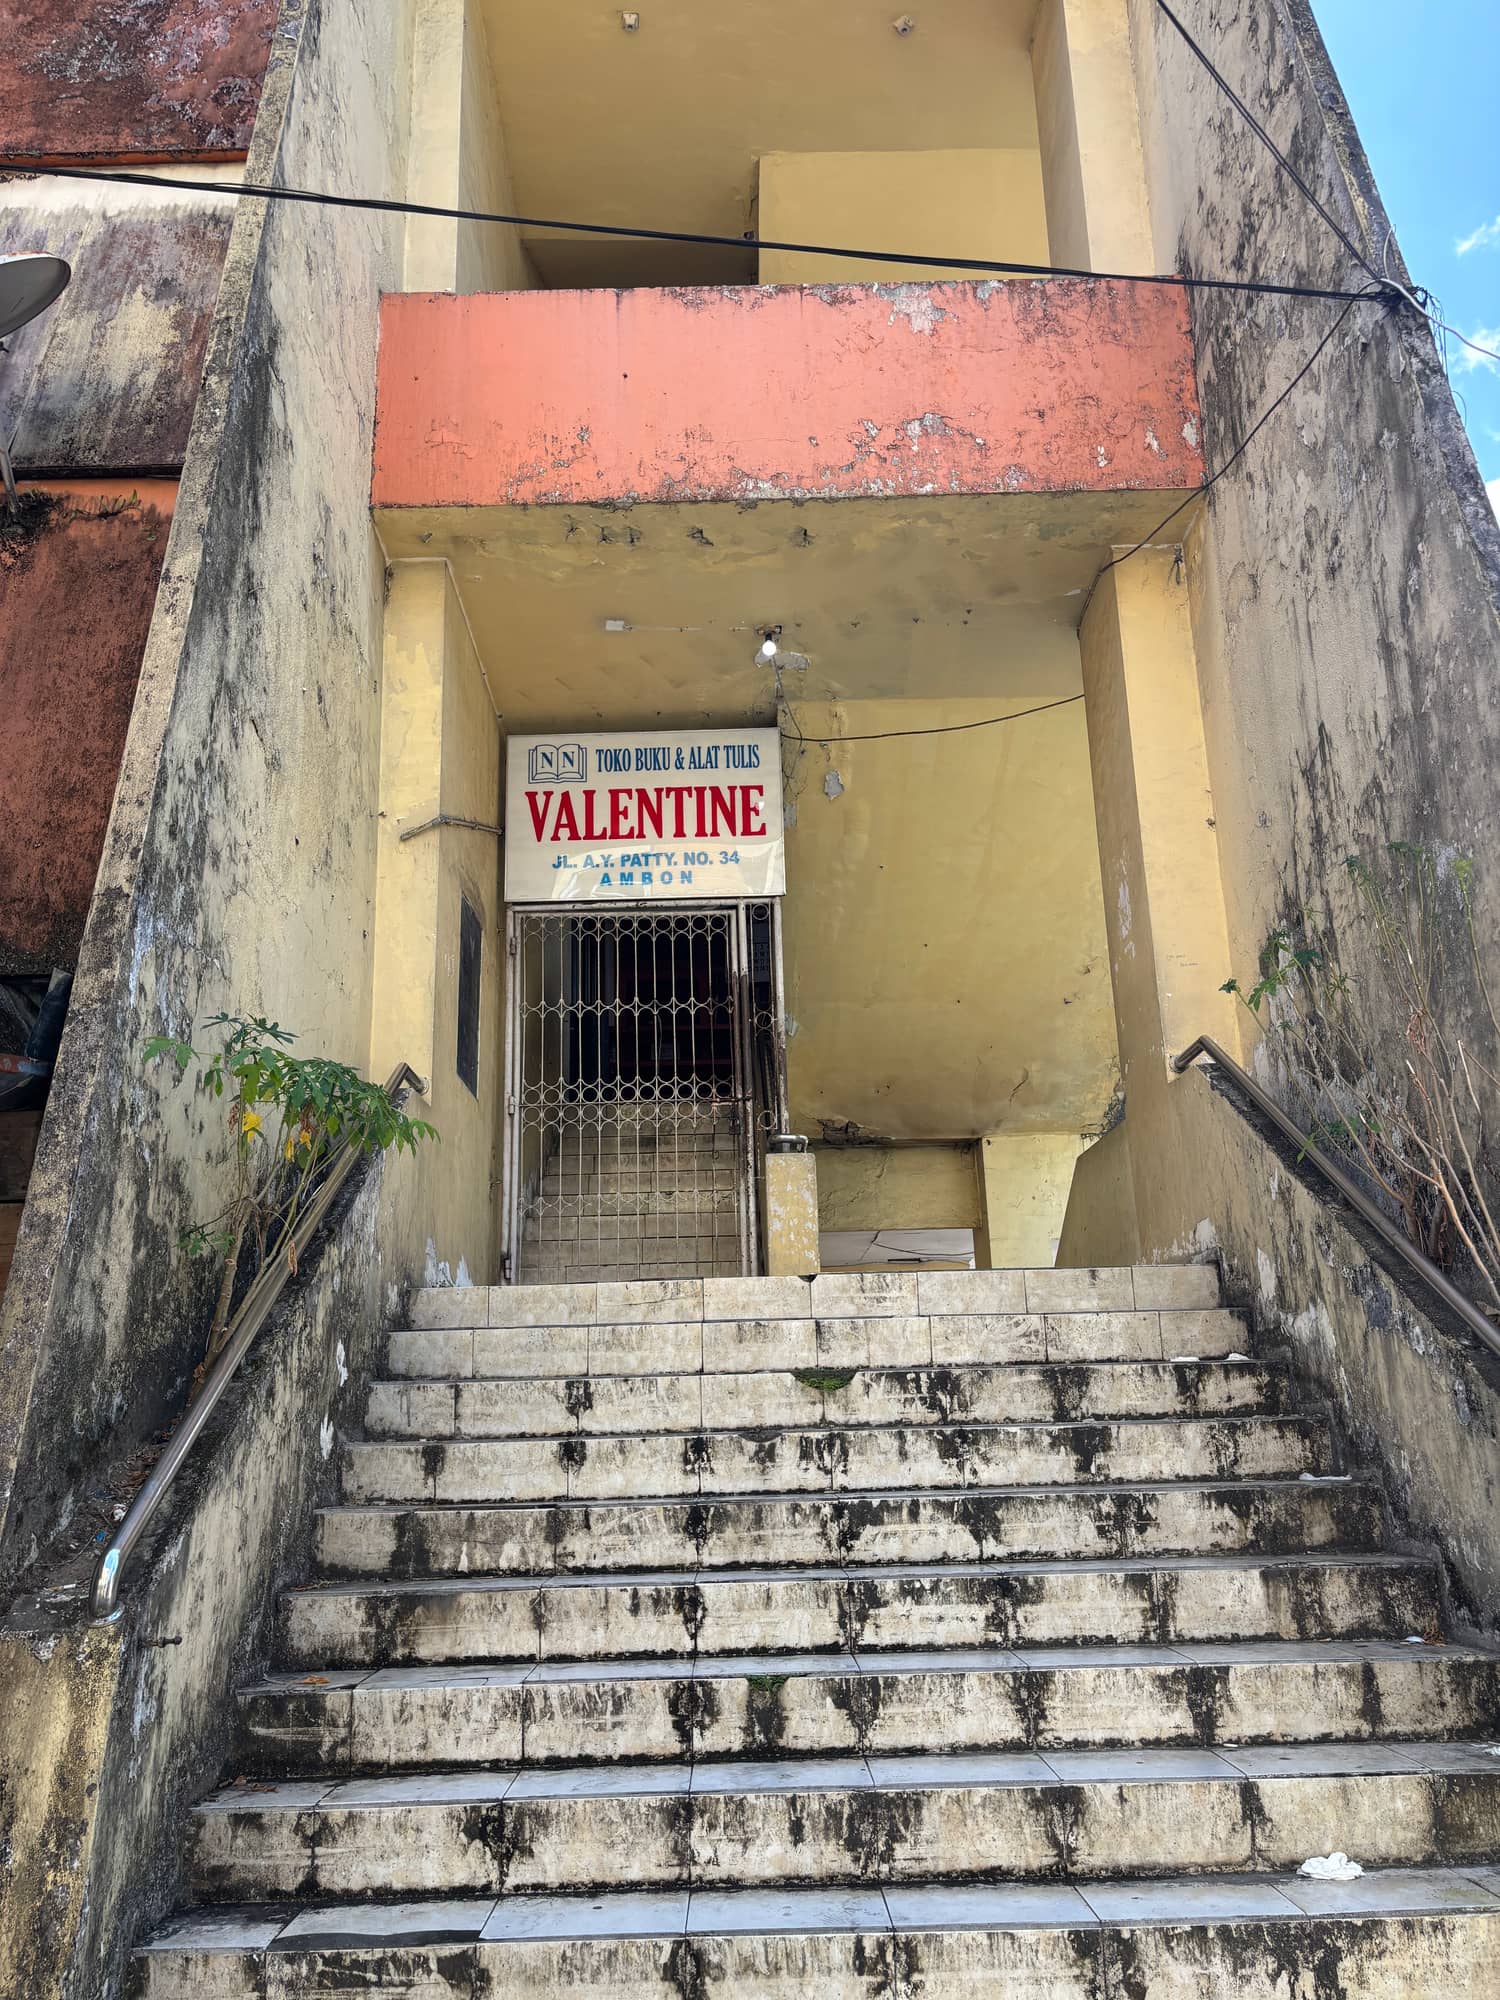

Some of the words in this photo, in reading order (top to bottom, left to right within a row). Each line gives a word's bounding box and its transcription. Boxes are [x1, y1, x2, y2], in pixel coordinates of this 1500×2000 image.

[595, 748, 631, 772] TOKO
[635, 747, 671, 771] BUKU
[675, 746, 685, 770] &
[688, 745, 720, 769] ALAT
[723, 744, 760, 768] TULIS
[524, 785, 767, 842] VALENTINE
[552, 855, 578, 869] JL.
[582, 854, 615, 868] A.Y.
[620, 852, 678, 867] PATTY.
[683, 851, 713, 866] NO.
[719, 850, 740, 865] 34
